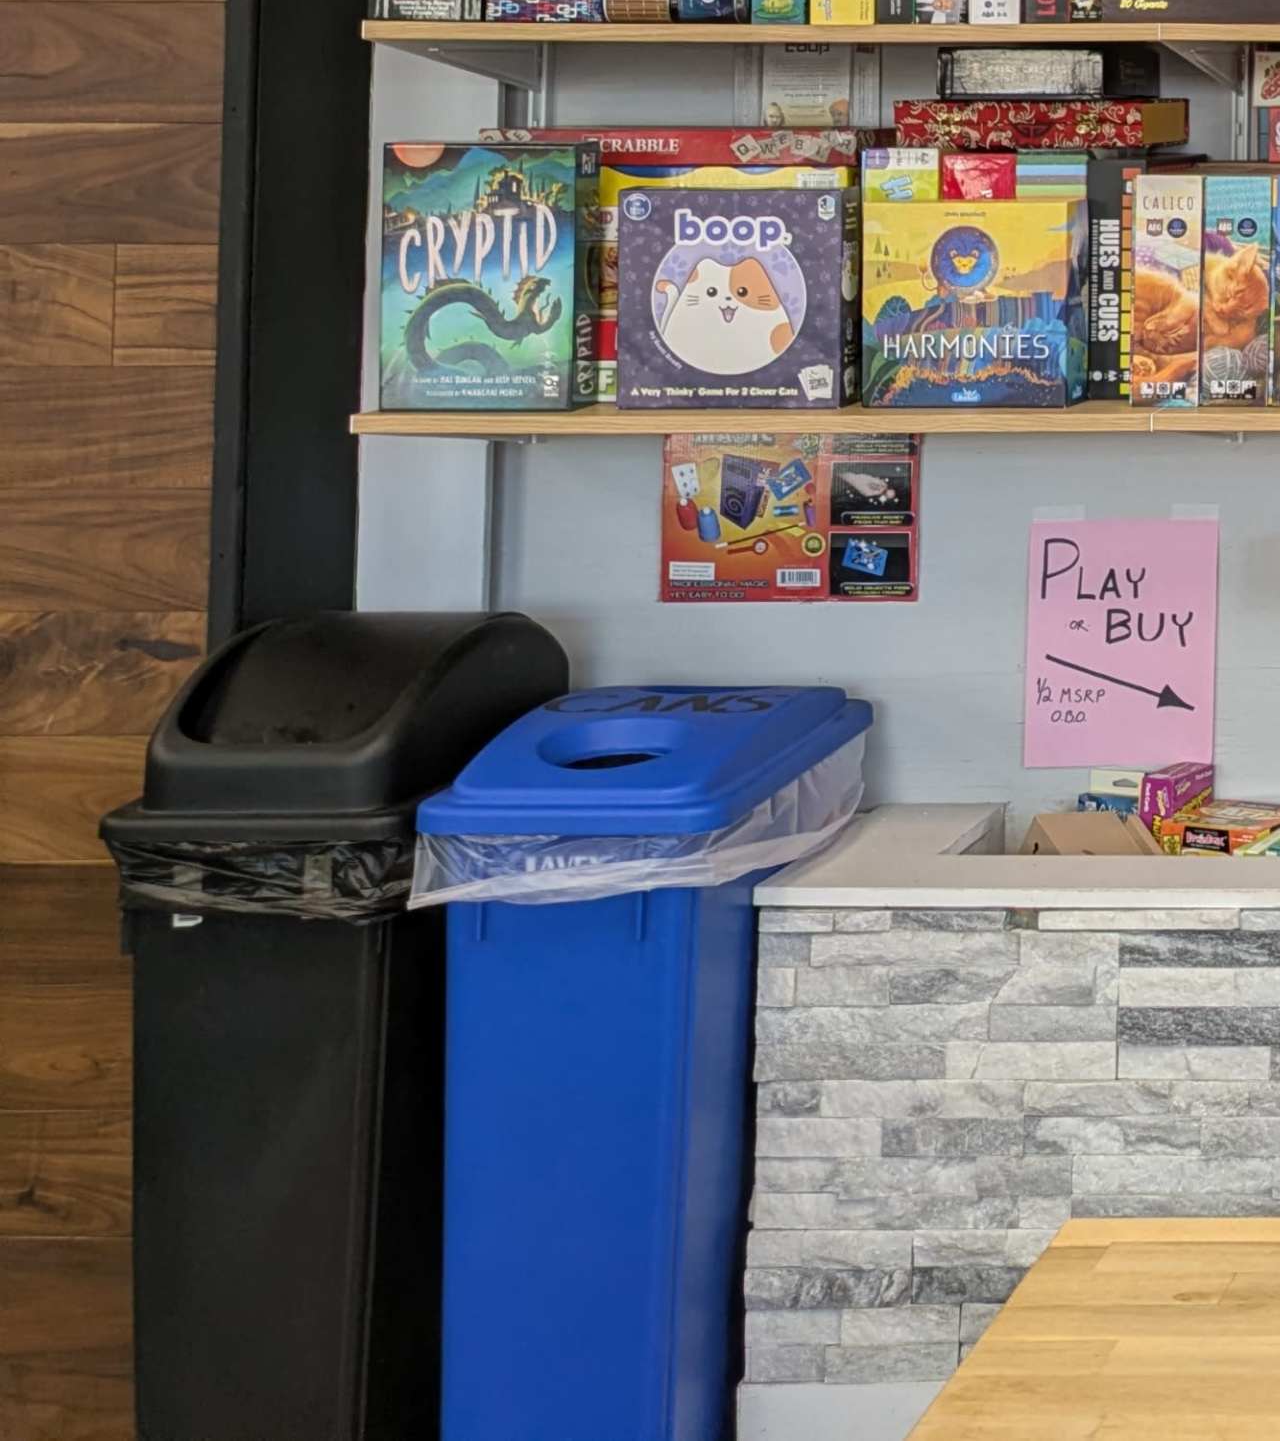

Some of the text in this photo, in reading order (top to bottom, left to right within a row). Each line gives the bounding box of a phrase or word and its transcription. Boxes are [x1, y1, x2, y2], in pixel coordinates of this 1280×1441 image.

[1143, 196, 1194, 210] CALICO
[399, 203, 558, 294] CRYPTID
[1098, 219, 1120, 342] HUES CUES
[884, 332, 1050, 360] HARMONIES
[1041, 538, 1146, 600] PLAY
[1069, 609, 1194, 647] OR BUY
[545, 693, 777, 715] CANS
[1059, 688, 1106, 703] MSRP
